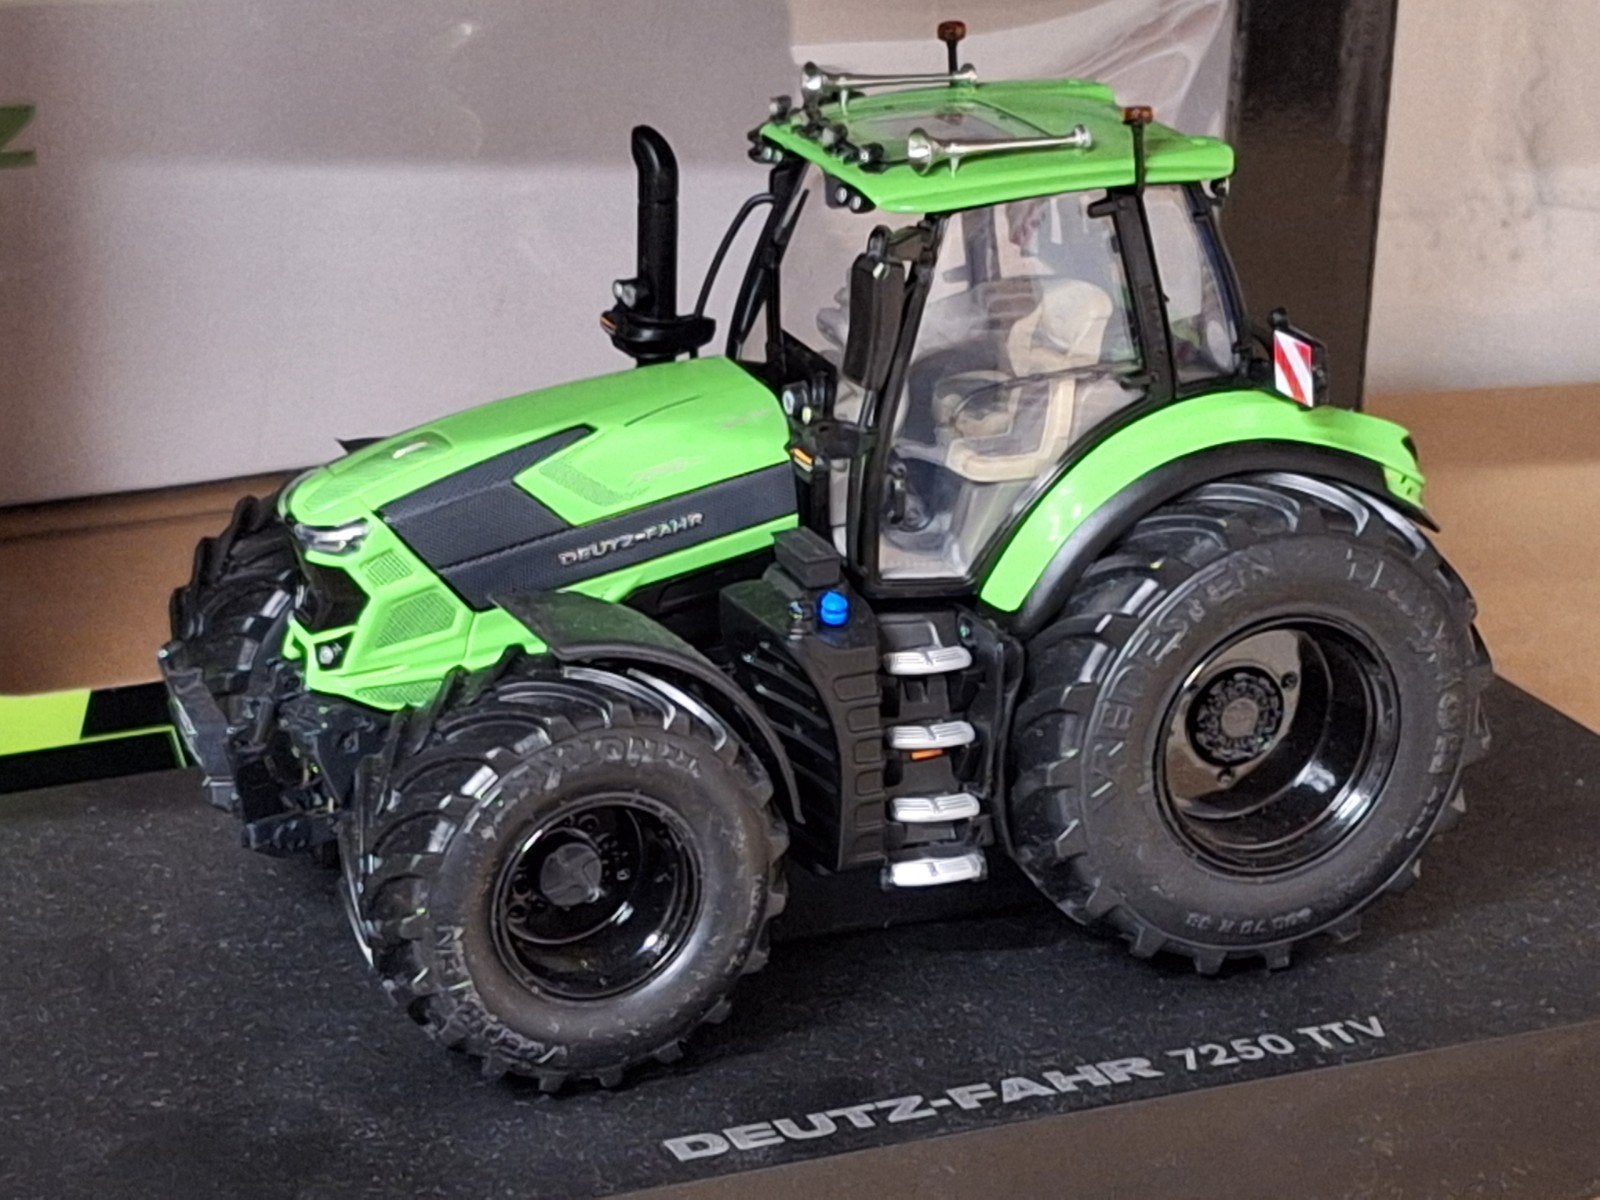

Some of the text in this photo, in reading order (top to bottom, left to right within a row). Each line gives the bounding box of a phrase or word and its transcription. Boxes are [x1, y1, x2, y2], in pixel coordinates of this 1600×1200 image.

[557, 512, 704, 566] DEUTZ-FAHR
[663, 1014, 1387, 1163] DEUTZ-FAHR 7250 TTV
